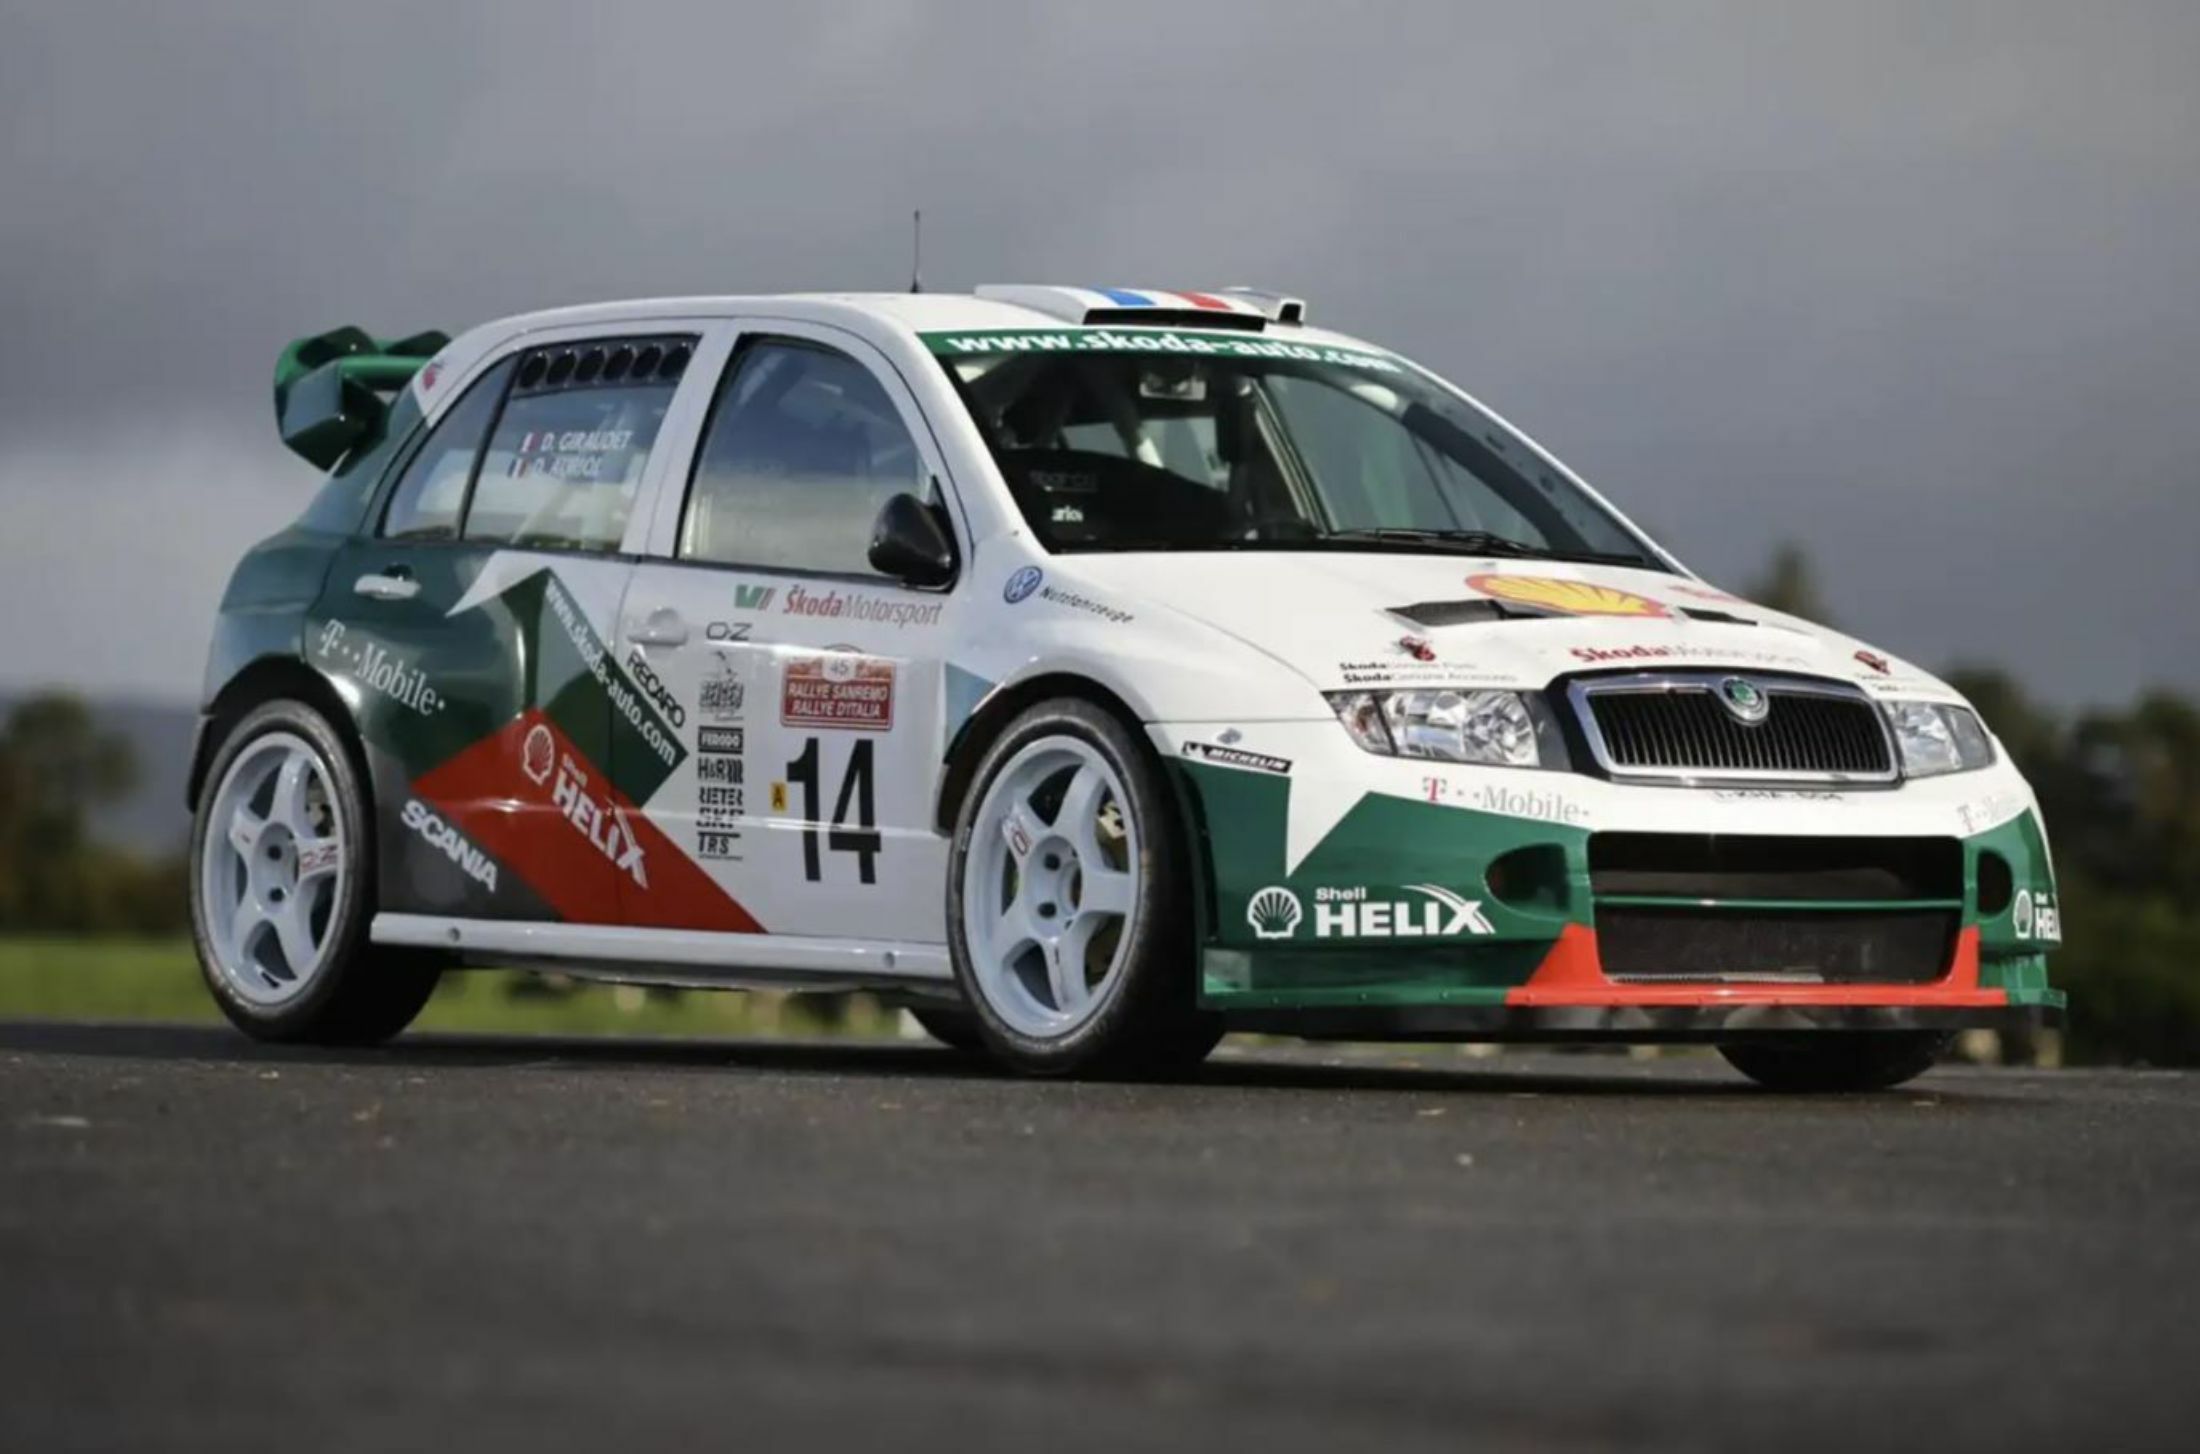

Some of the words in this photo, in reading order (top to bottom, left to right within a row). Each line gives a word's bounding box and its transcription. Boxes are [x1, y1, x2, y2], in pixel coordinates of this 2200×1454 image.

[946, 331, 1402, 373] www.skoda-auto.com
[559, 430, 633, 451] GIRAUDET
[627, 649, 686, 729] RECARO
[788, 683, 829, 699] RALLYE
[832, 684, 888, 702] SANREMO
[792, 700, 833, 717] RALLYE
[701, 732, 741, 746] FERODO
[1207, 748, 1288, 770] MICHELIN
[786, 737, 882, 885] 14
[552, 767, 648, 889] HELIX
[401, 799, 498, 893] SCANIA
[1314, 886, 1367, 902] Shell
[1314, 884, 1496, 937] HELIX
